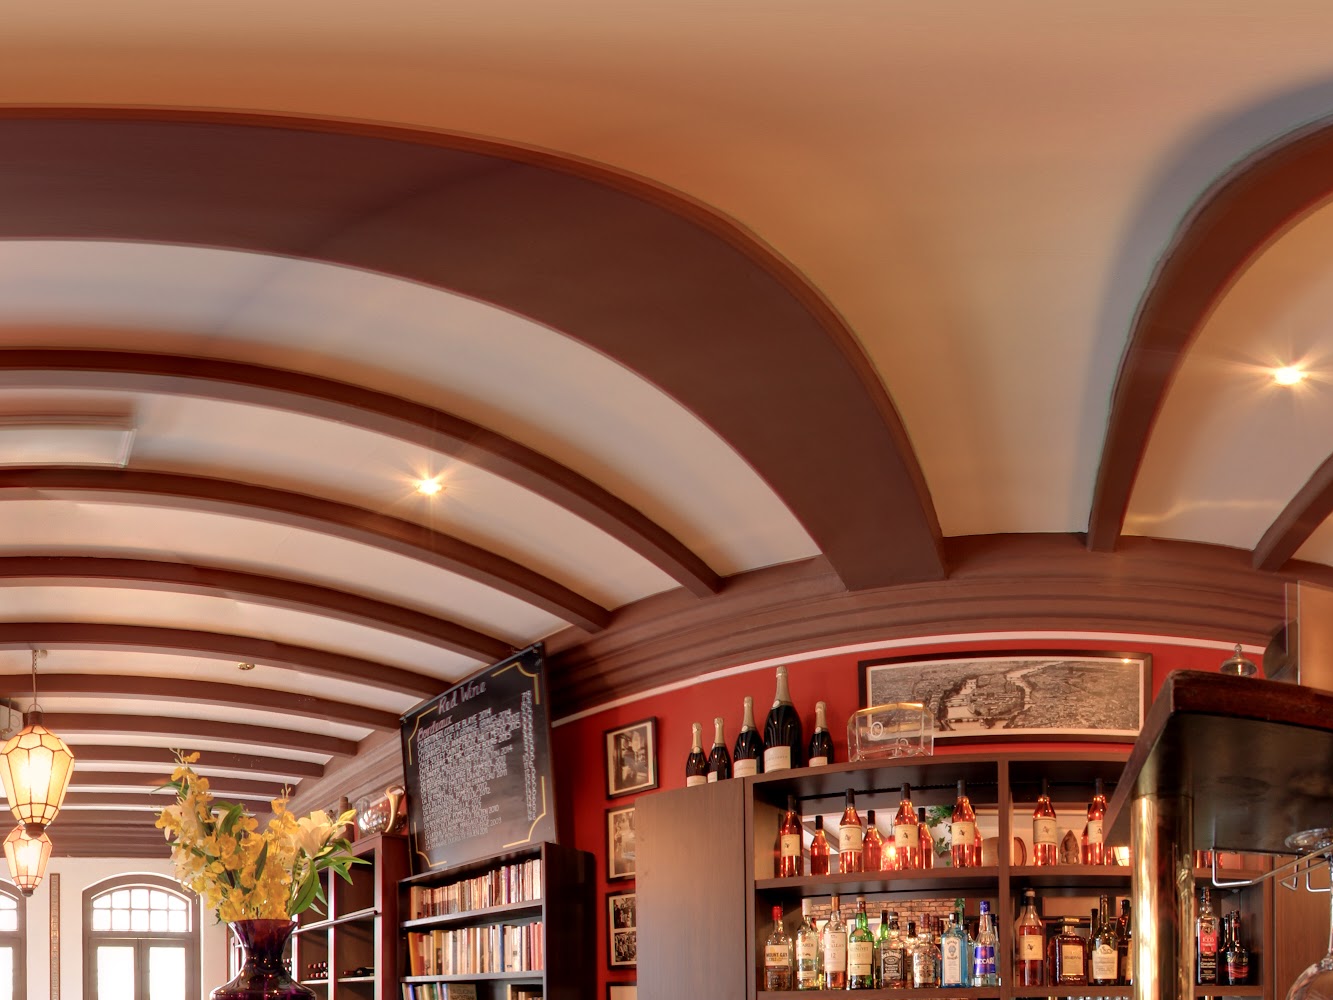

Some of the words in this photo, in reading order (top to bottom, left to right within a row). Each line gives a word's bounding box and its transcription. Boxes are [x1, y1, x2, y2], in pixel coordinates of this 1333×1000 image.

[438, 690, 458, 714] Red
[460, 681, 486, 702] Wine
[417, 715, 452, 742] Bordeaux
